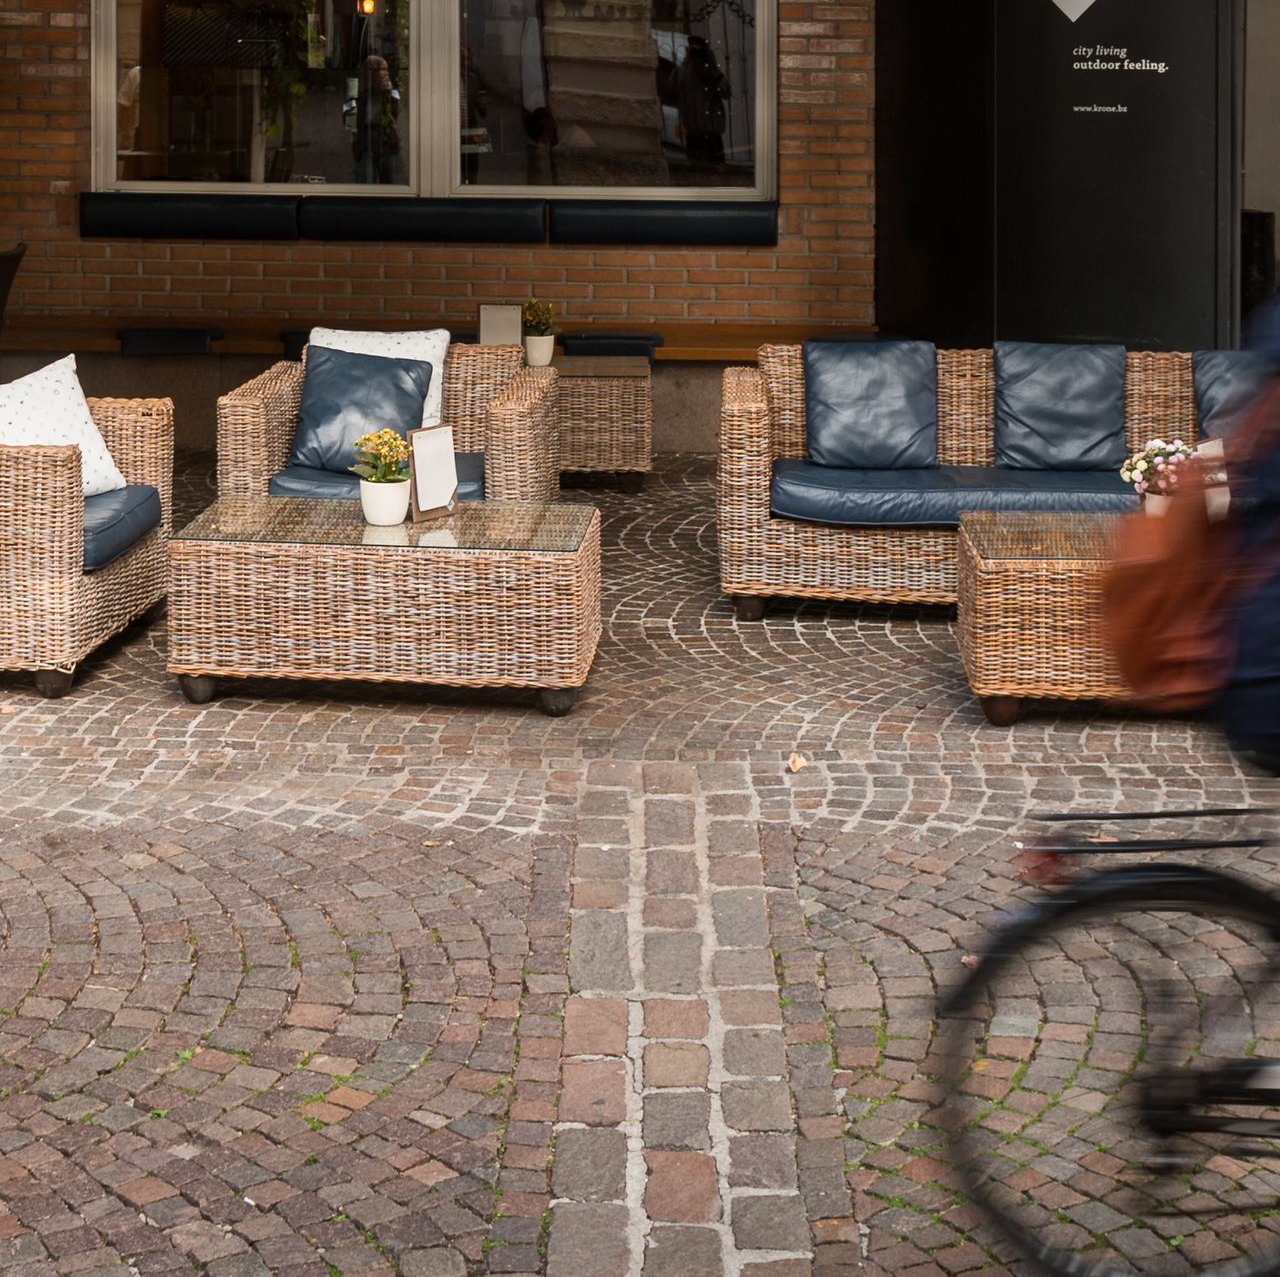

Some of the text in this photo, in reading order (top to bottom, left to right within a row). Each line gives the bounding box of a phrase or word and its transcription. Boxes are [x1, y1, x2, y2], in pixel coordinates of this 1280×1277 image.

[1072, 44, 1128, 59] city living
[1073, 59, 1169, 73] outdoor feeling.
[1073, 103, 1128, 112] www.krone.bz
